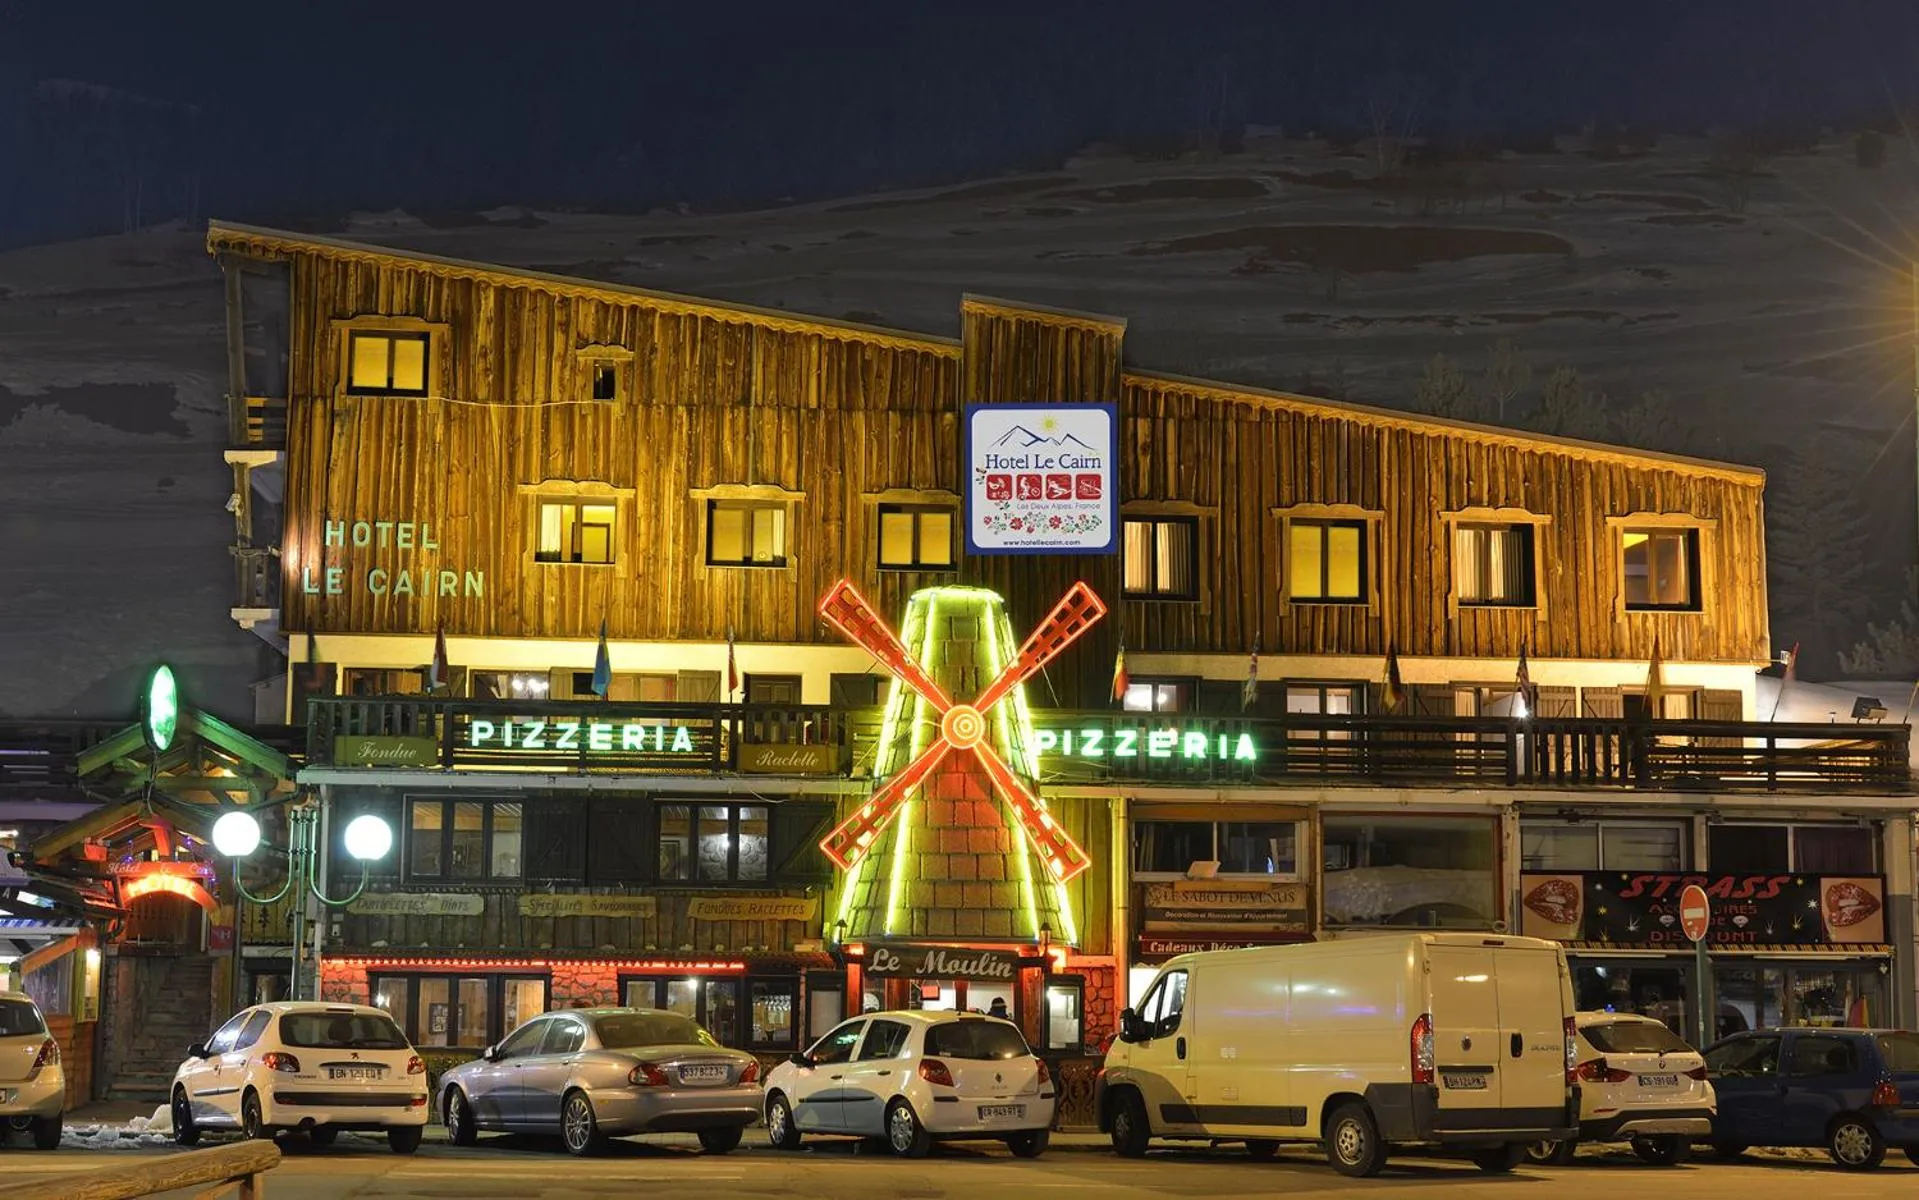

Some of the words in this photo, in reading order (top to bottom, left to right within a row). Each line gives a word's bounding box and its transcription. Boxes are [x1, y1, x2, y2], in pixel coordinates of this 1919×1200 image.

[985, 454, 1029, 469] Hotel
[1035, 454, 1054, 469] Le
[1059, 454, 1101, 469] Cairn
[1031, 502, 1049, 510] Deux
[1075, 502, 1101, 510] France
[325, 519, 440, 549] HOTEL
[303, 567, 344, 594] LE
[368, 569, 484, 597] CAIRN
[471, 720, 693, 752] PIZZERIA
[1034, 729, 1257, 760] PIZZERIA
[357, 742, 417, 760] Fondue
[756, 749, 820, 767] Raclette
[1618, 875, 1791, 899] STRASS
[1150, 941, 1205, 953] Cadeaux
[868, 948, 900, 972] Le
[915, 950, 1013, 978] Moulin
